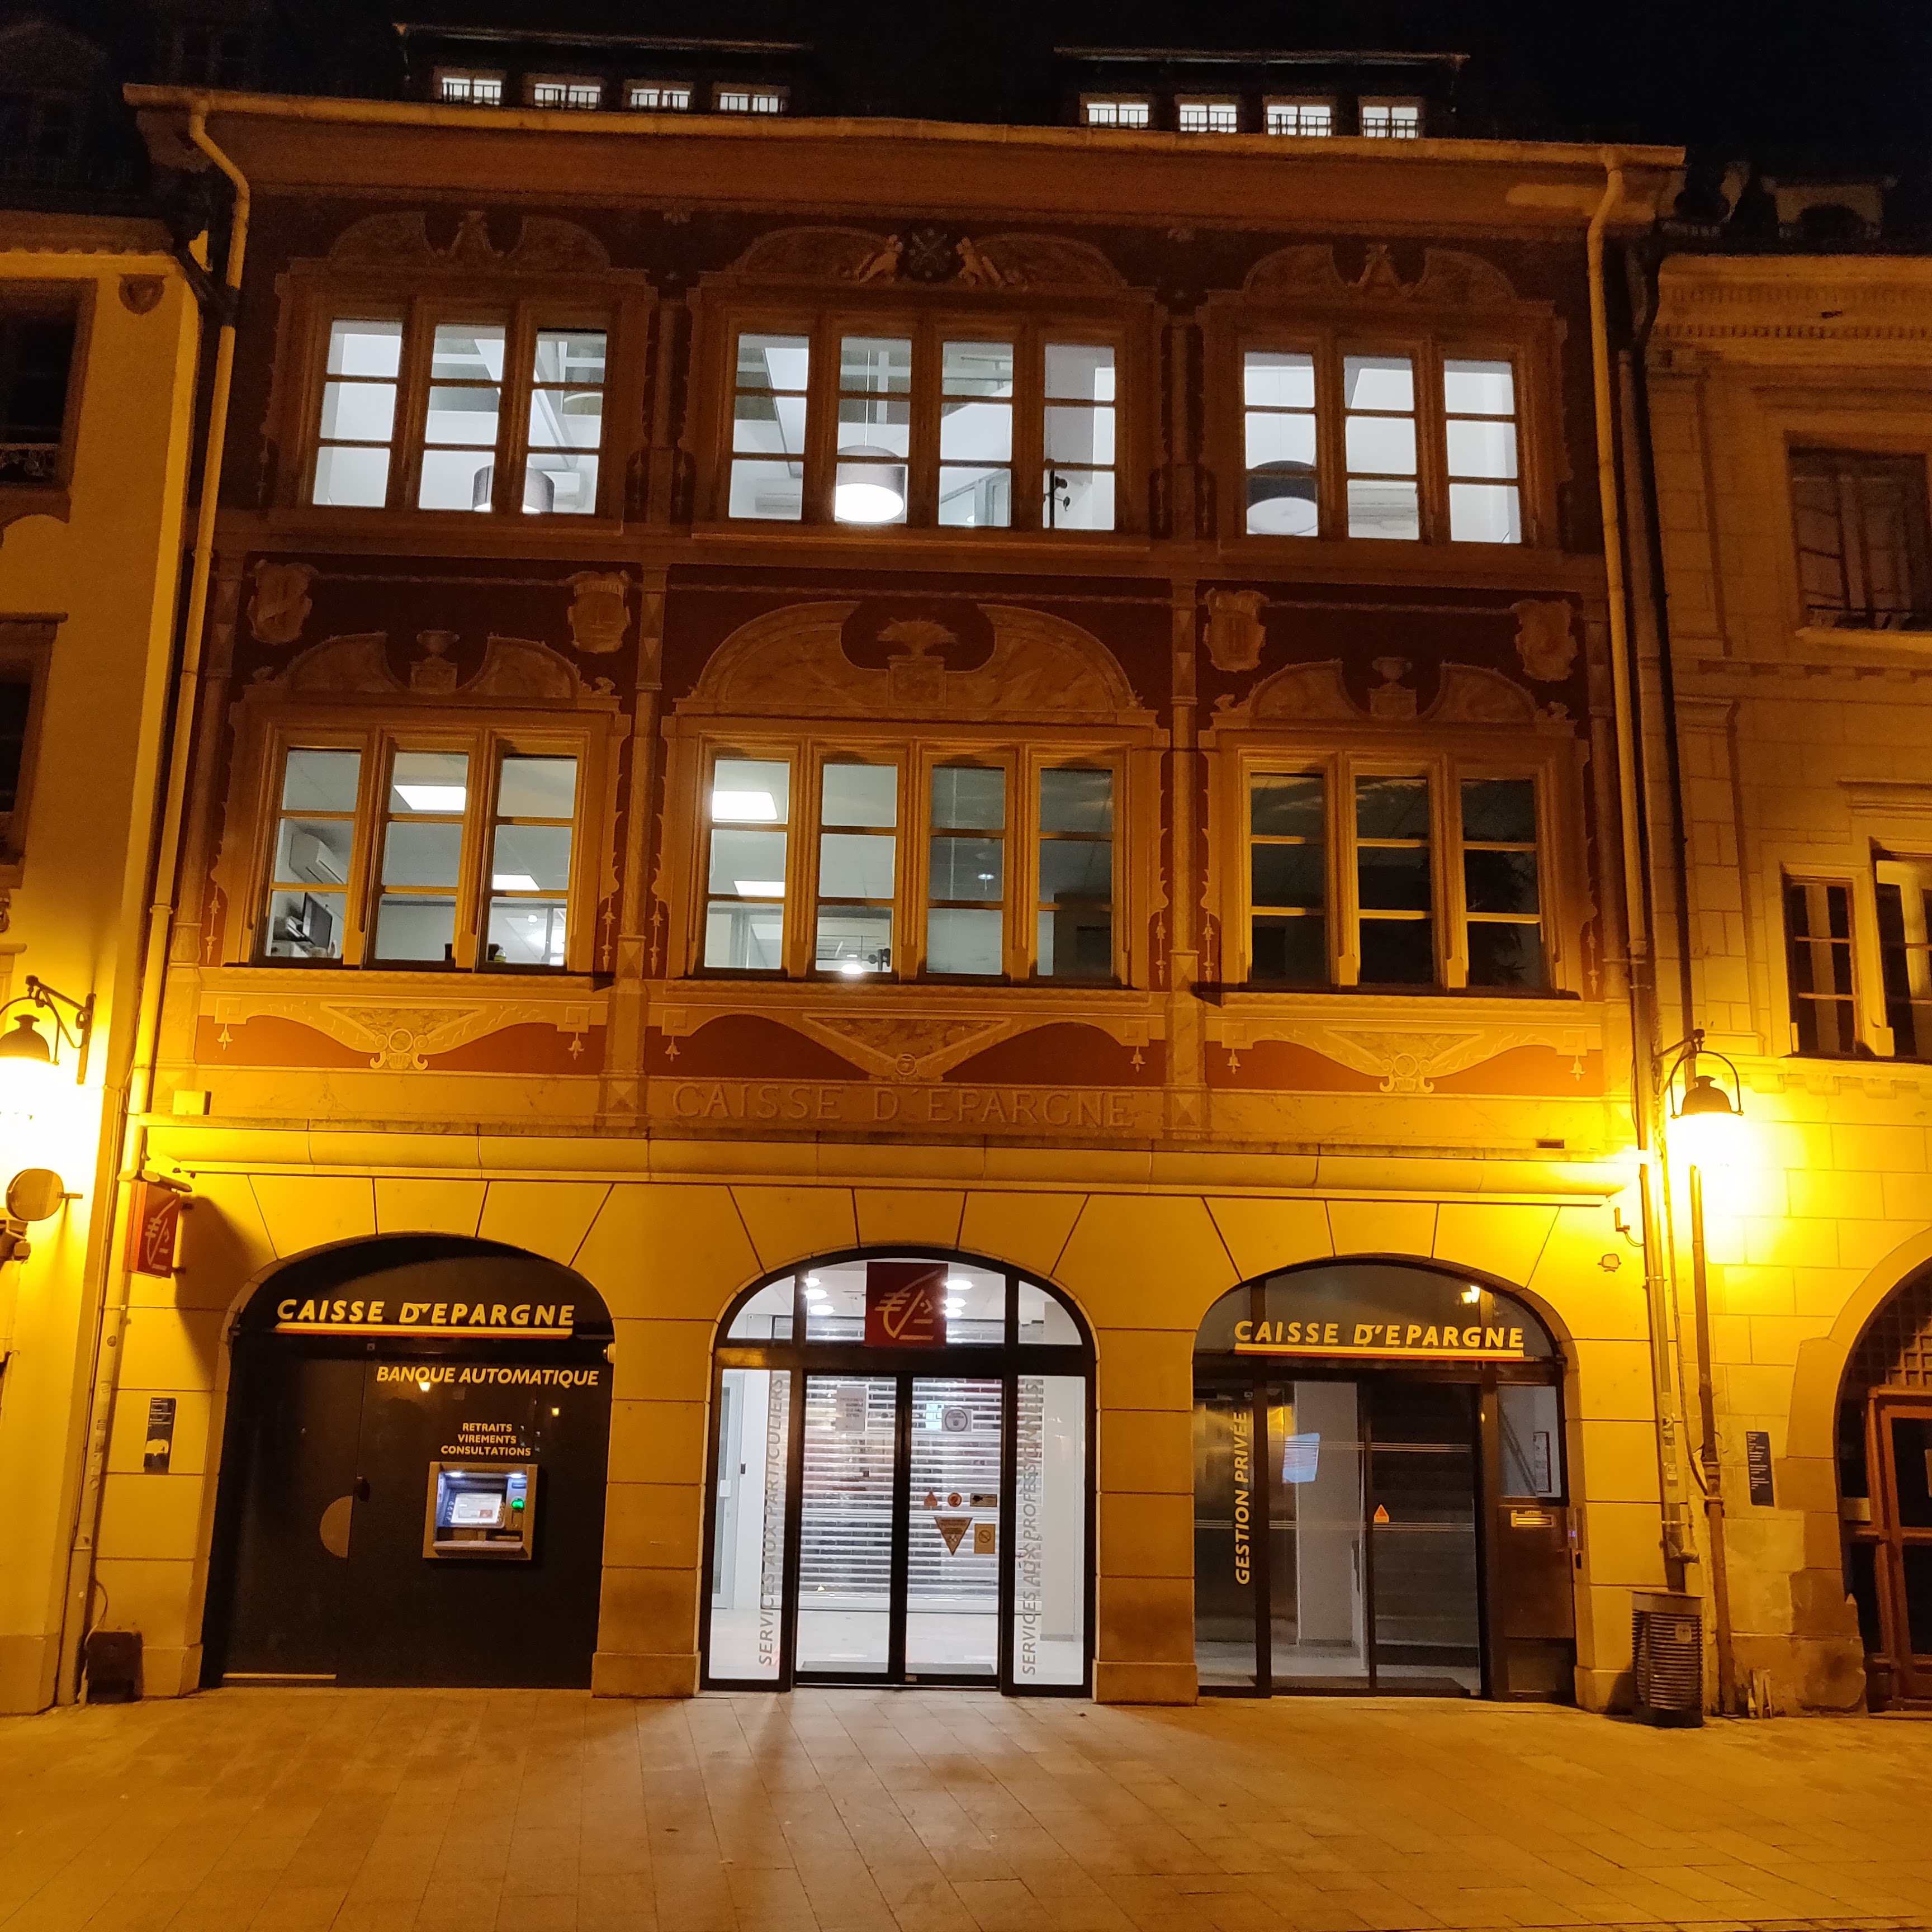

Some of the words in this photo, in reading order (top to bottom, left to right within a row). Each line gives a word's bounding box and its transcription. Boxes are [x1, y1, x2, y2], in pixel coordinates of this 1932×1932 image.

[673, 1082, 842, 1120] CAISSE
[277, 1299, 385, 1322] CAISSE
[399, 1302, 575, 1325] D'EPARGNE
[1234, 1321, 1339, 1344] CAISSE
[1353, 1324, 1524, 1348] D'EPARGNE
[376, 1367, 454, 1385] BANQUE
[458, 1368, 599, 1388] AUTOMATIQUE
[457, 1434, 517, 1444] VIREMENTS
[462, 1423, 513, 1432] RETRAITS
[441, 1446, 531, 1456] CONSULTATIONS
[765, 1380, 783, 1515] PARTICULIERS
[1230, 1412, 1248, 1483] PRIVÉE
[763, 1525, 776, 1565] AUX
[1235, 1489, 1249, 1584] GESTION
[1024, 1545, 1036, 1586] AUX
[759, 1574, 775, 1665] SERVICES
[1022, 1592, 1036, 1675] SERVICES
